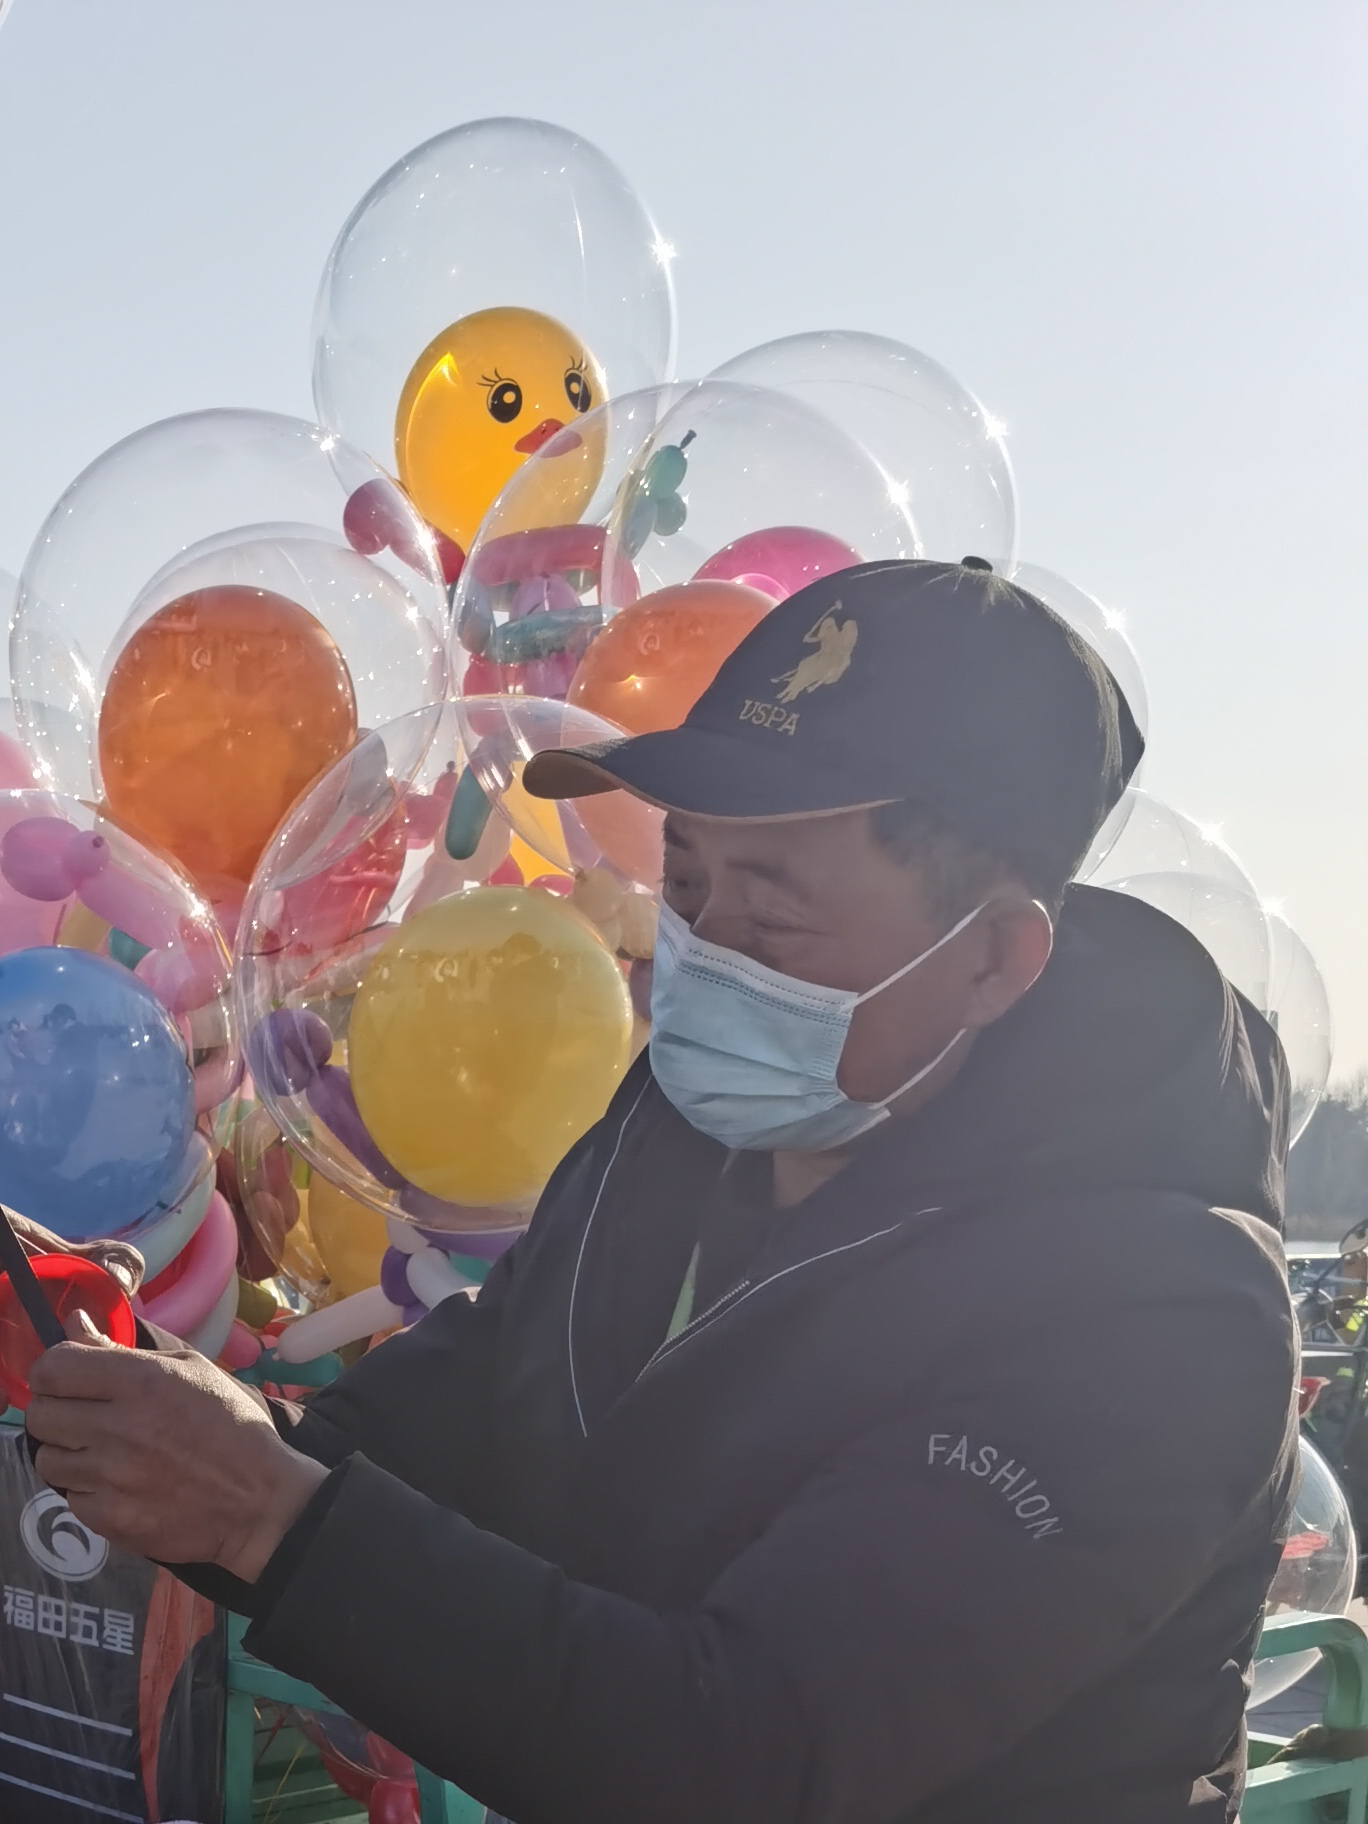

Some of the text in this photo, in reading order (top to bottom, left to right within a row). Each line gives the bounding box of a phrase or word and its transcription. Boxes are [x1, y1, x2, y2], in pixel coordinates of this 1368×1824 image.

[739, 700, 800, 736] USPA
[928, 1433, 1064, 1539] FASHION
[3, 1584, 135, 1656] 福田五星
